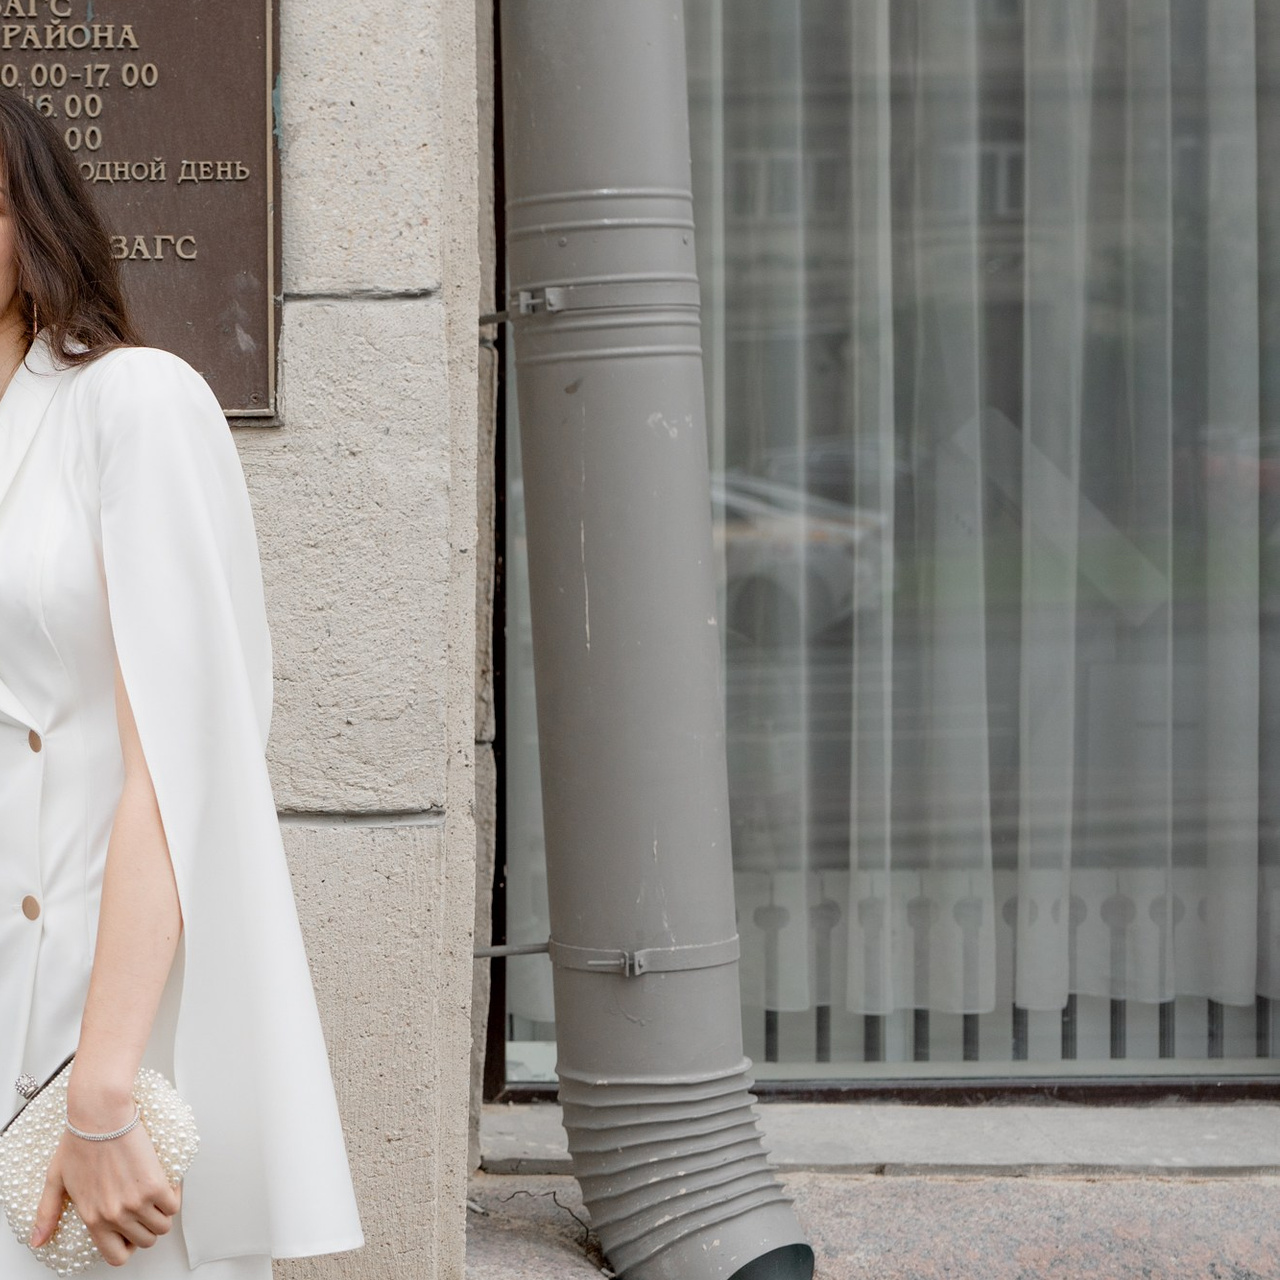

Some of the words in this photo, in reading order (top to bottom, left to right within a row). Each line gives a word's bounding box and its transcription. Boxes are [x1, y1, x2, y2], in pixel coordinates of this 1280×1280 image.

[1, 19, 140, 50] РАЙОНА
[79, 156, 167, 185] ОДНОЙ
[177, 159, 251, 185] ДЕНЬ
